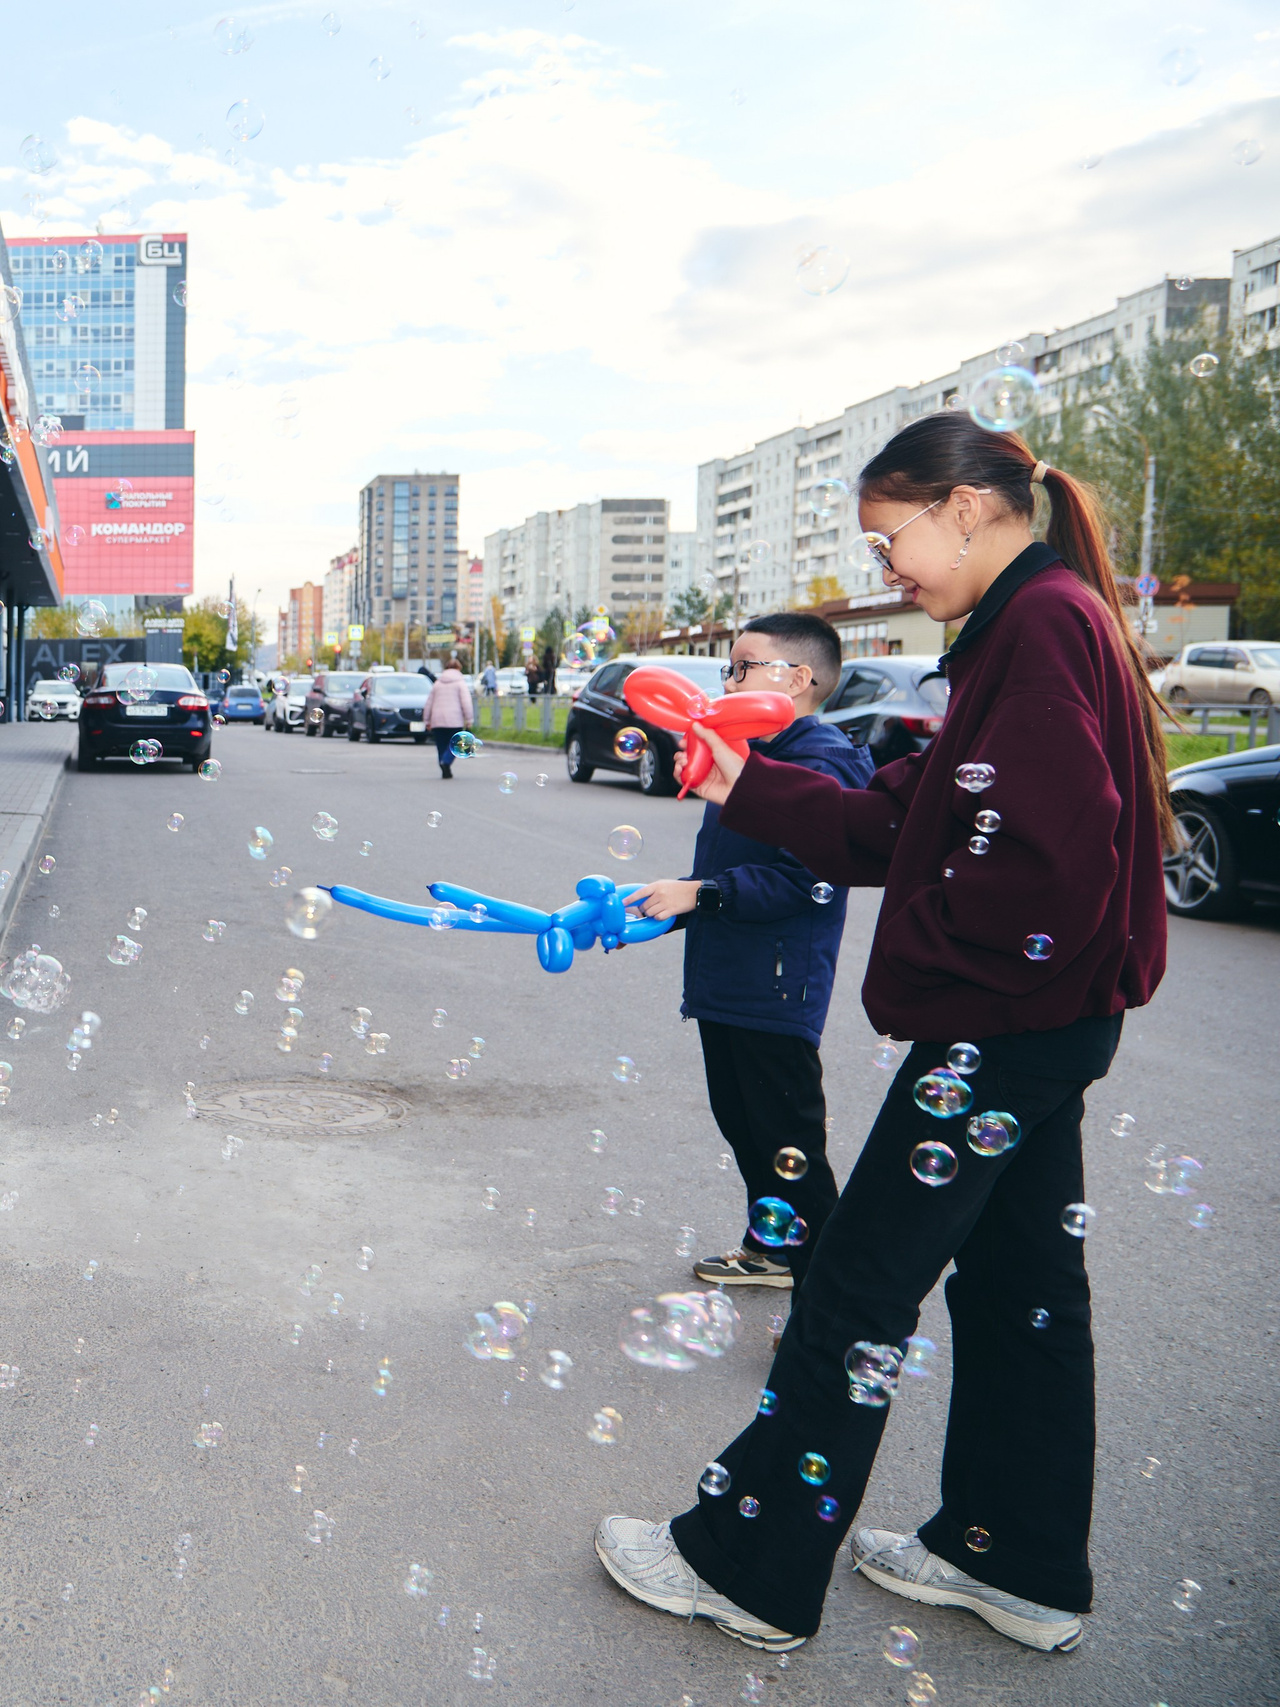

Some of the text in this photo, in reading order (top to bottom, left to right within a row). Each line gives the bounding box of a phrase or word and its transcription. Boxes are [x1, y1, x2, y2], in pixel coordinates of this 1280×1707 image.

[122, 500, 167, 508] ПОКРЫТИЯ
[91, 522, 186, 536] КОМАНДОР
[105, 536, 171, 544] СУПЕРМАРКЕТ
[32, 643, 127, 668] ALEX
